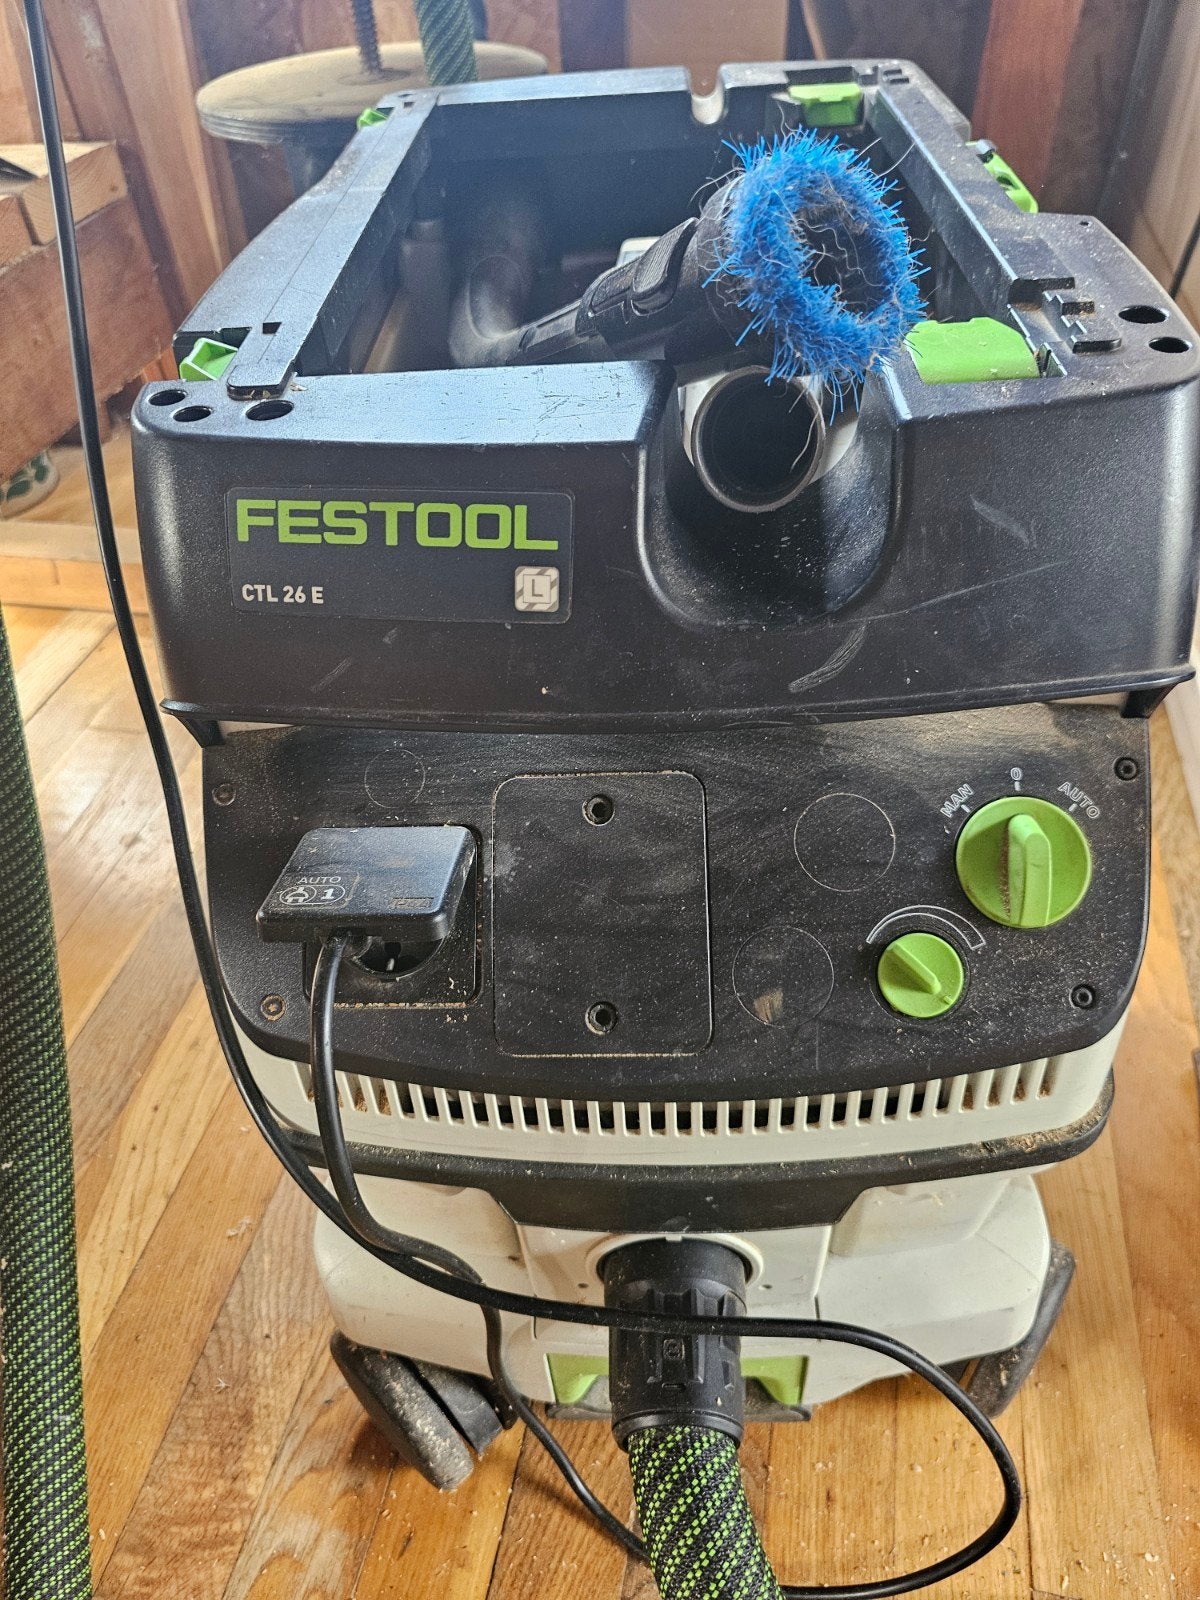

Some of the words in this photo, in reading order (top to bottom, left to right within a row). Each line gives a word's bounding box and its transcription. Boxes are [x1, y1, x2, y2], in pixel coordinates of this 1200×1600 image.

[236, 499, 559, 550] FESTOOL
[241, 584, 279, 602] CTL
[282, 585, 307, 604] 26
[311, 586, 324, 604] E
[531, 578, 544, 598] L
[1010, 767, 1023, 781] 0
[940, 783, 975, 819] MAN
[1057, 781, 1101, 820] AUTO
[297, 876, 342, 885] AUTO
[320, 888, 336, 900] 1
